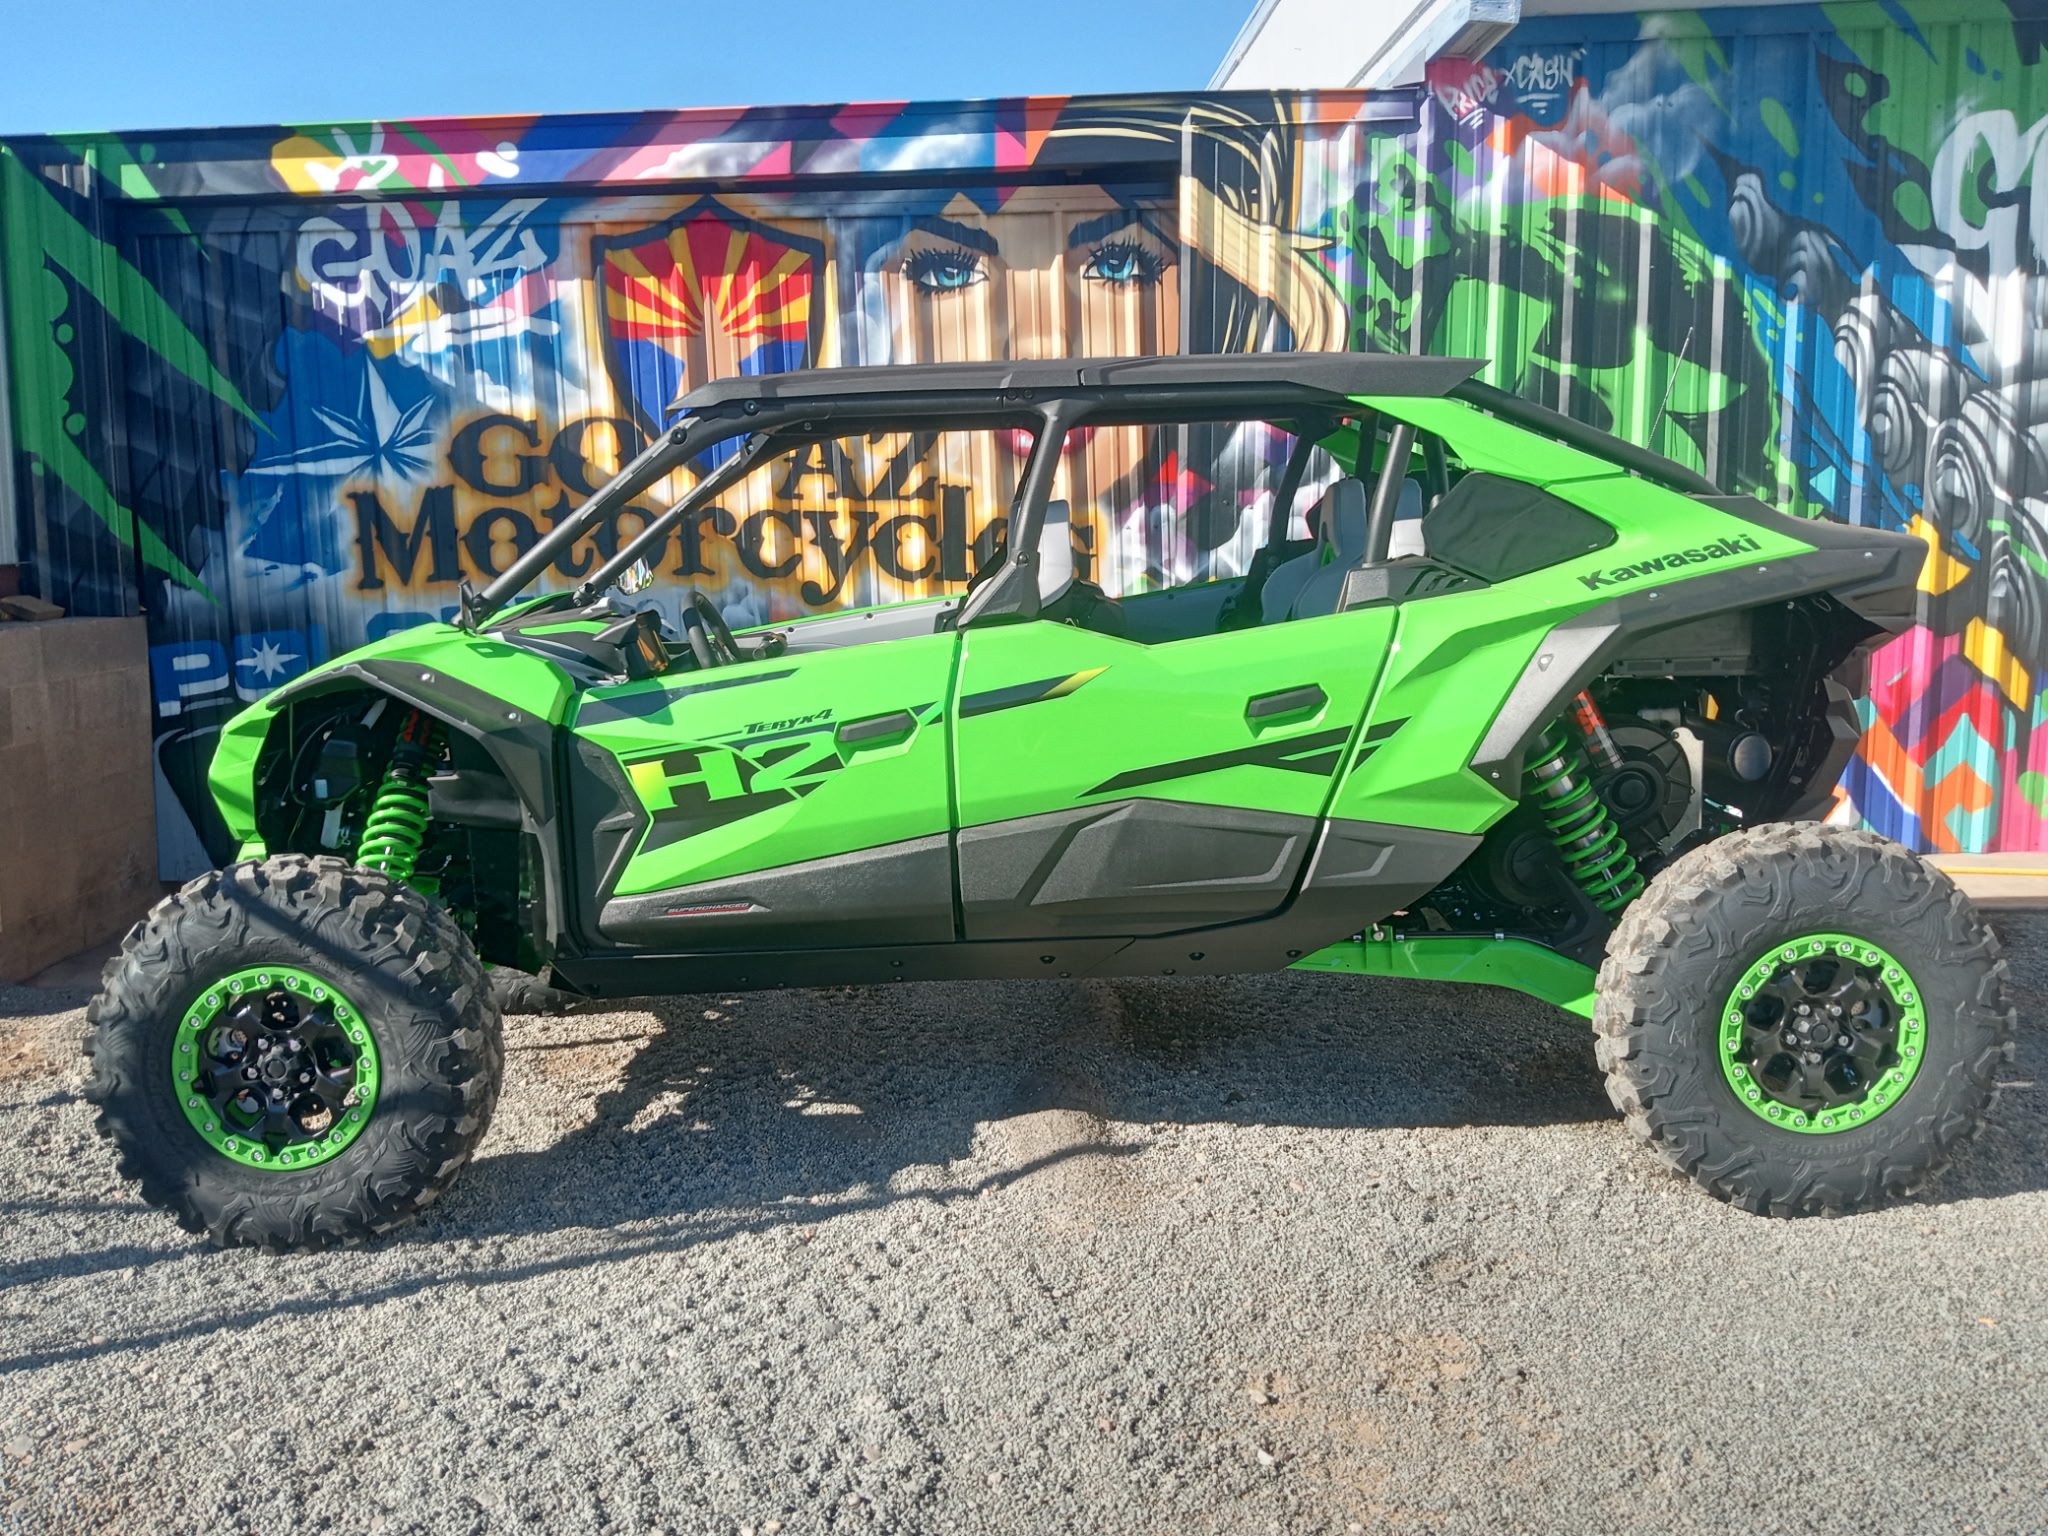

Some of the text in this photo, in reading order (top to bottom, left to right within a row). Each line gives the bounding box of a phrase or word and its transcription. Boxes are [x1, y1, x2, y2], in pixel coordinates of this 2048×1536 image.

[1575, 533, 1762, 591] Kawasaki
[627, 731, 839, 811] H2
[667, 902, 749, 913] SUPERCHARGED
